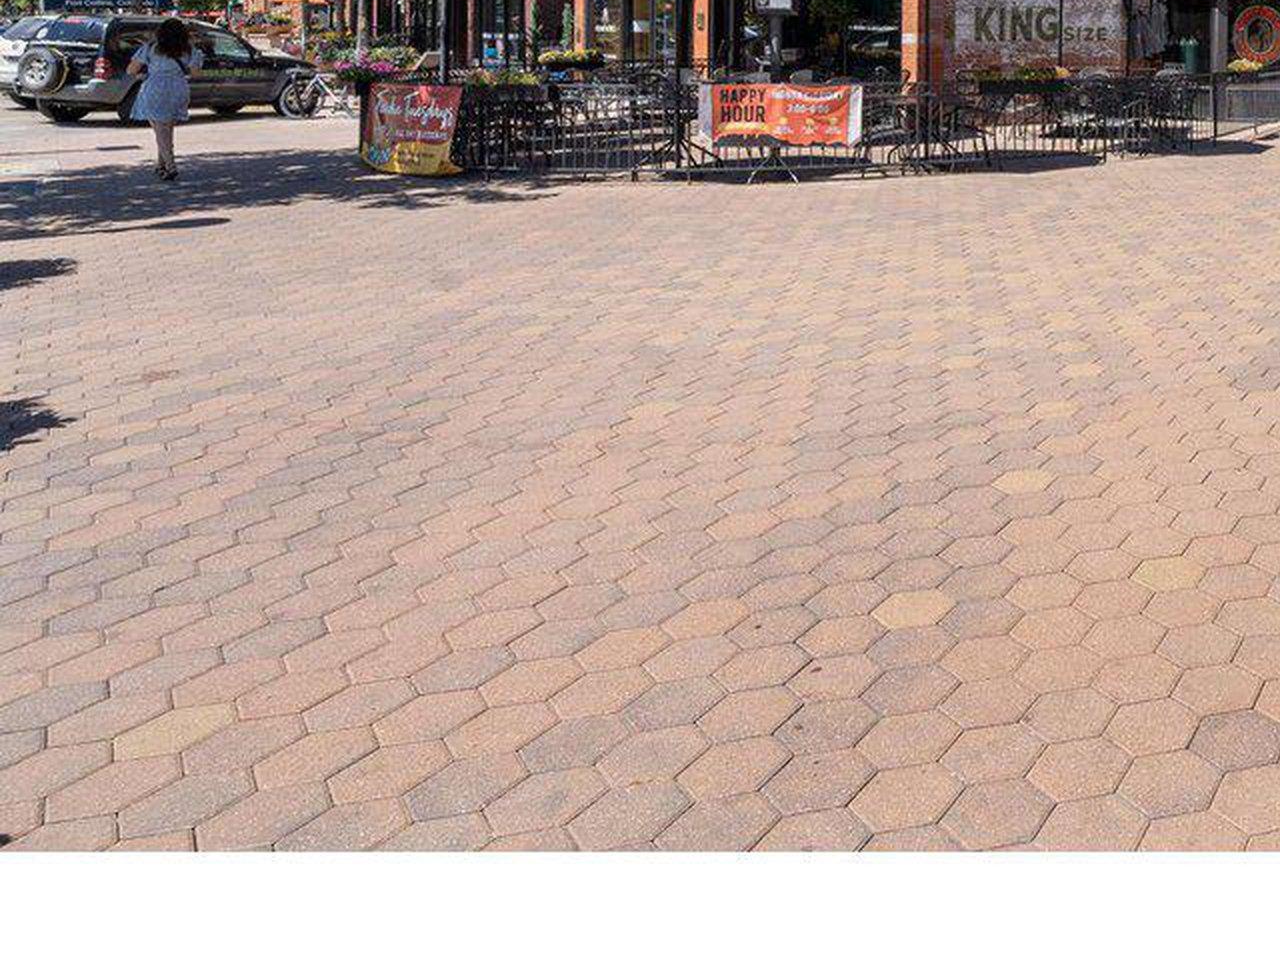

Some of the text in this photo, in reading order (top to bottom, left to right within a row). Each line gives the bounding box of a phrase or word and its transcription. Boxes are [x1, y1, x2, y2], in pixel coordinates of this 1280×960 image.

[973, 6, 1108, 41] KING SIZE
[719, 89, 767, 103] HAPPY
[719, 105, 766, 123] HOUR
